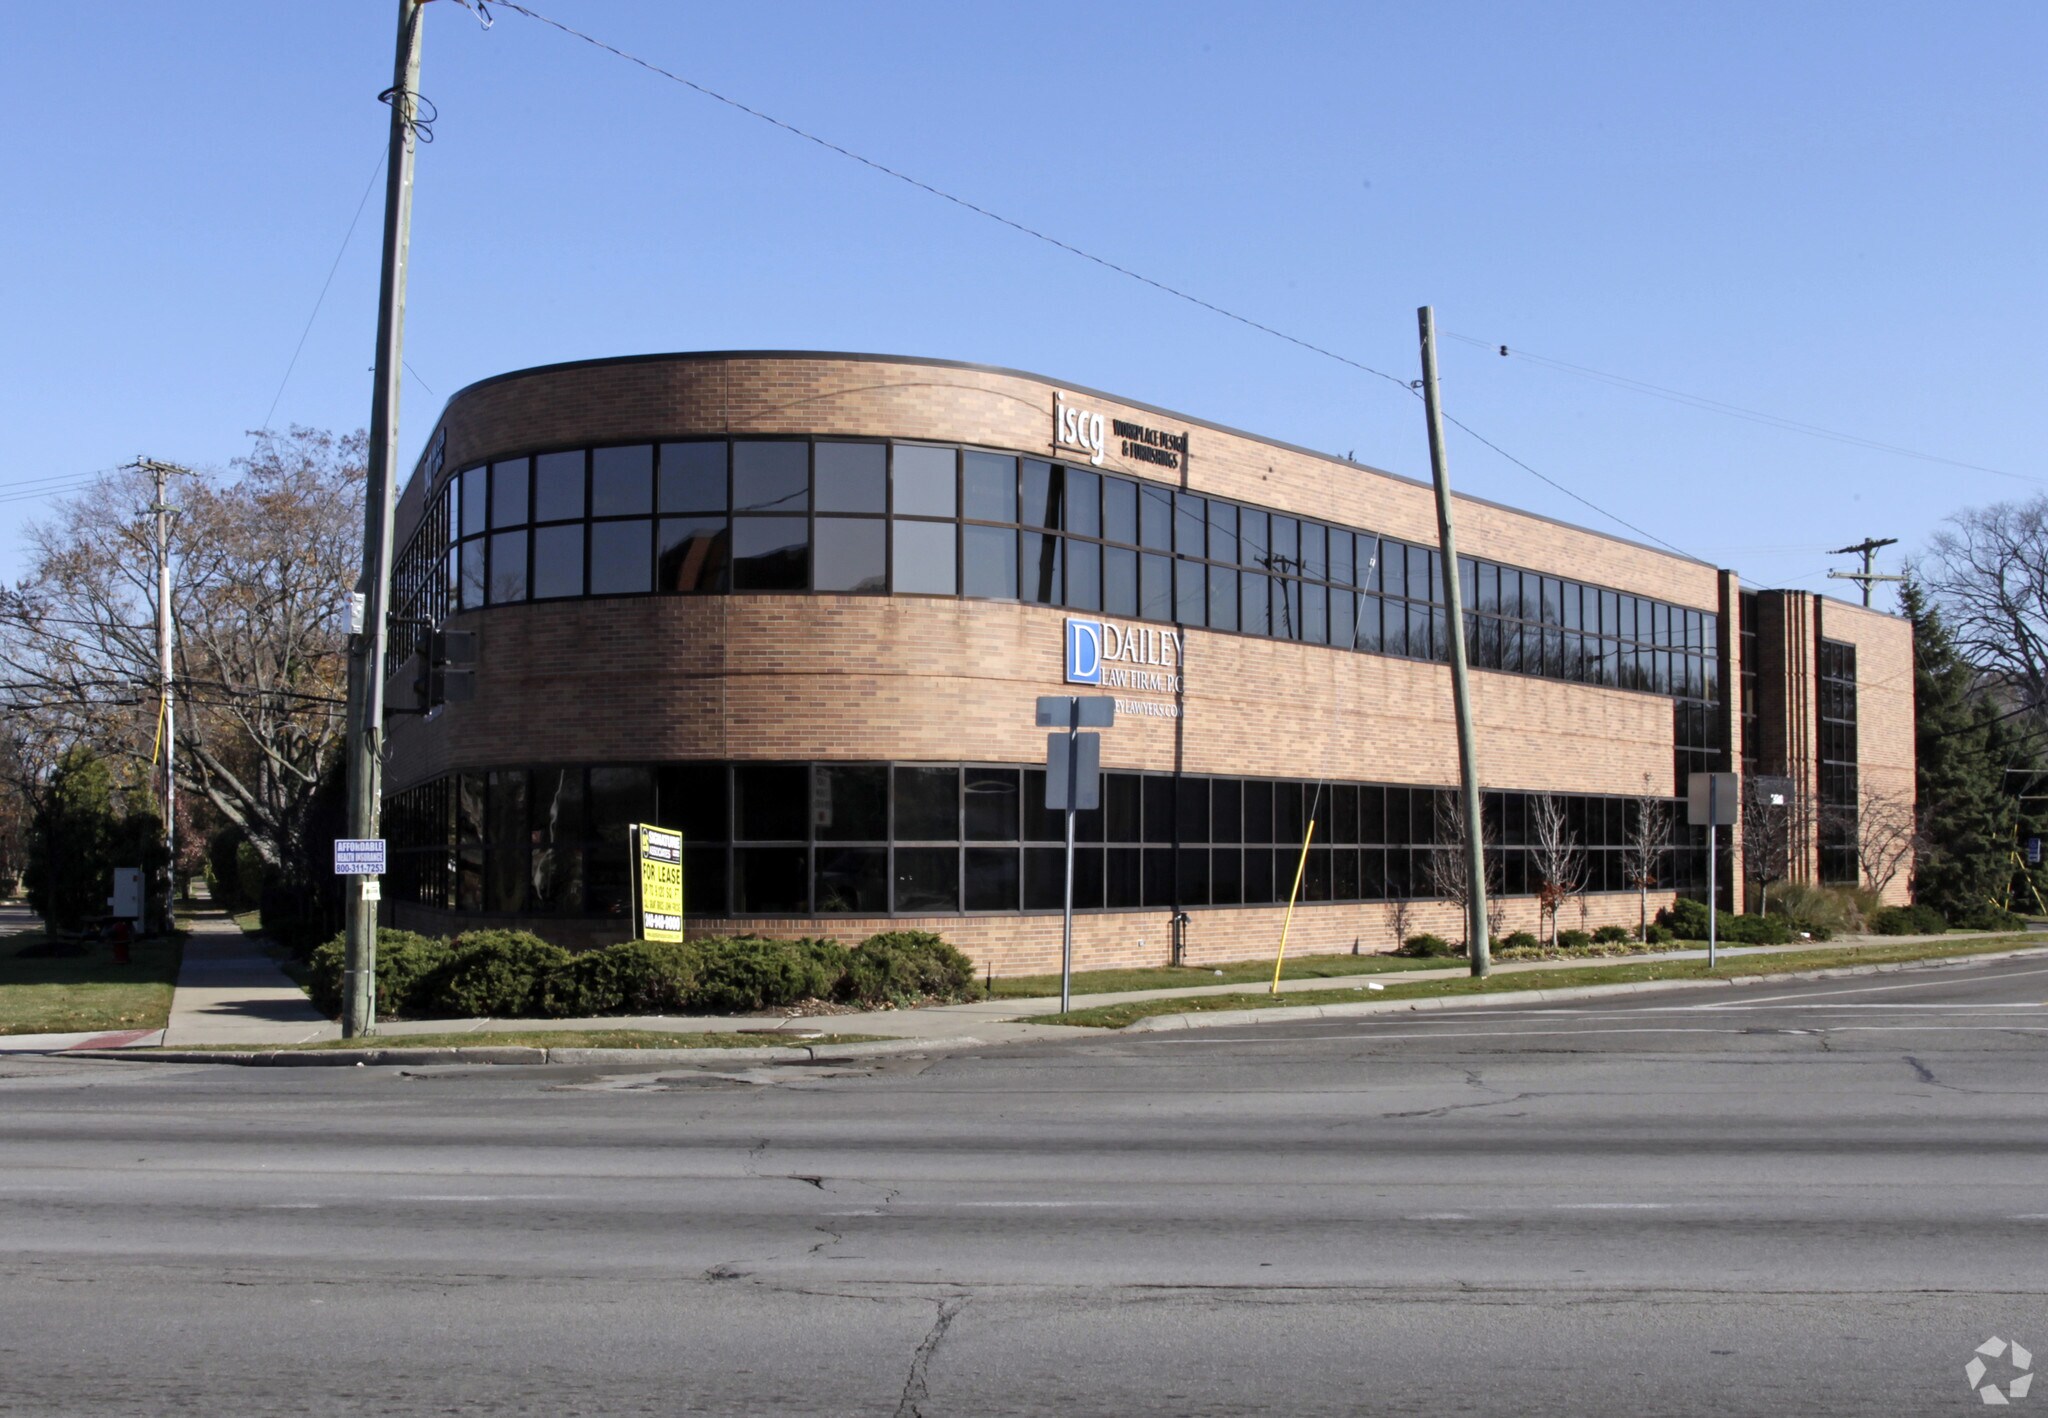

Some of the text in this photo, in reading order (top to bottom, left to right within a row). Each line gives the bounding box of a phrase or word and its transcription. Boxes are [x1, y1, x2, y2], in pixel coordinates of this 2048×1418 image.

[1056, 391, 1104, 466] iscg
[1112, 418, 1187, 453] WORKPLACE DESIGN
[1121, 440, 1178, 469] & FURNISHINGS
[1072, 623, 1099, 677] D
[1101, 623, 1185, 667] DAILEY
[1101, 667, 1128, 688] LAW
[337, 841, 383, 852] AFFORDABLE
[355, 852, 383, 862] INSURANCE
[336, 864, 384, 873] 800-311-7253
[643, 862, 681, 885] FOR LEASE
